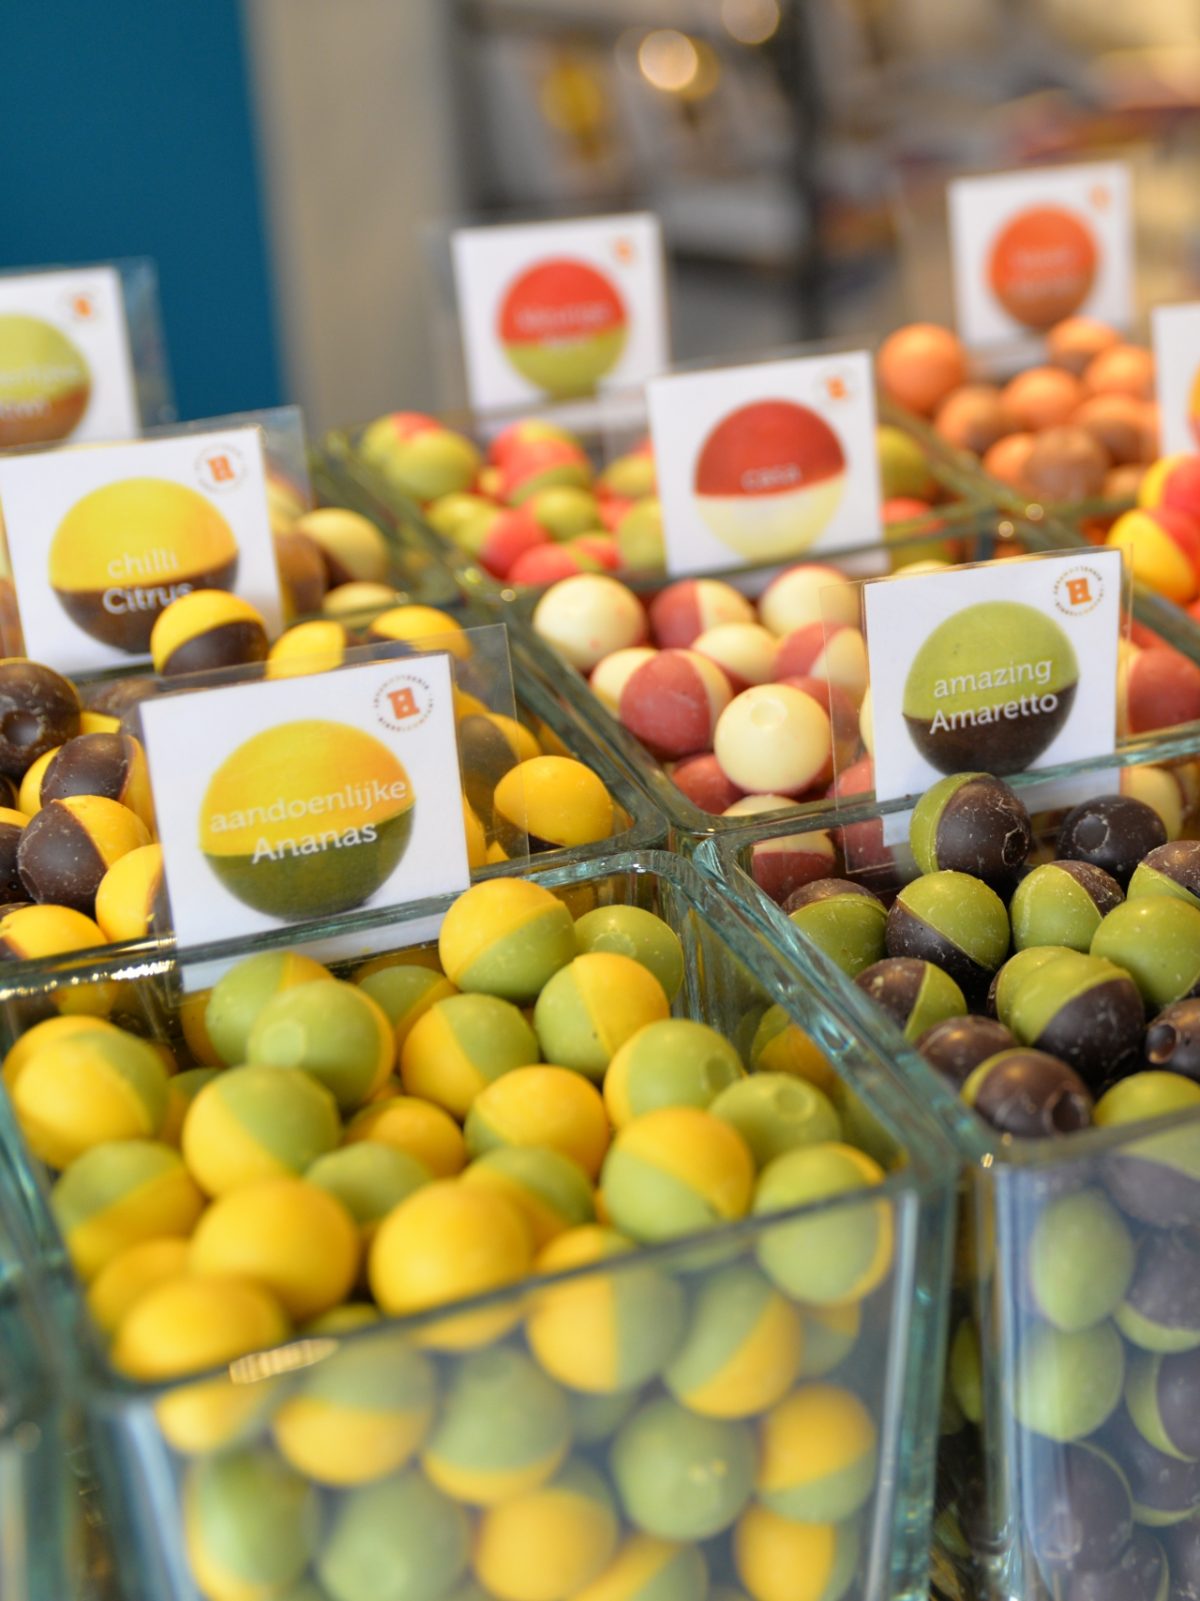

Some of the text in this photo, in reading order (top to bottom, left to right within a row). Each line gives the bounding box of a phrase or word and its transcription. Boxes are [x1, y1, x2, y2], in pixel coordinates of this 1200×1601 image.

[107, 547, 179, 579] chilli
[933, 660, 1053, 699] amazing
[929, 693, 1059, 735] Amaretto
[209, 779, 407, 833] aandoenlijke
[251, 823, 378, 864] Ananas
